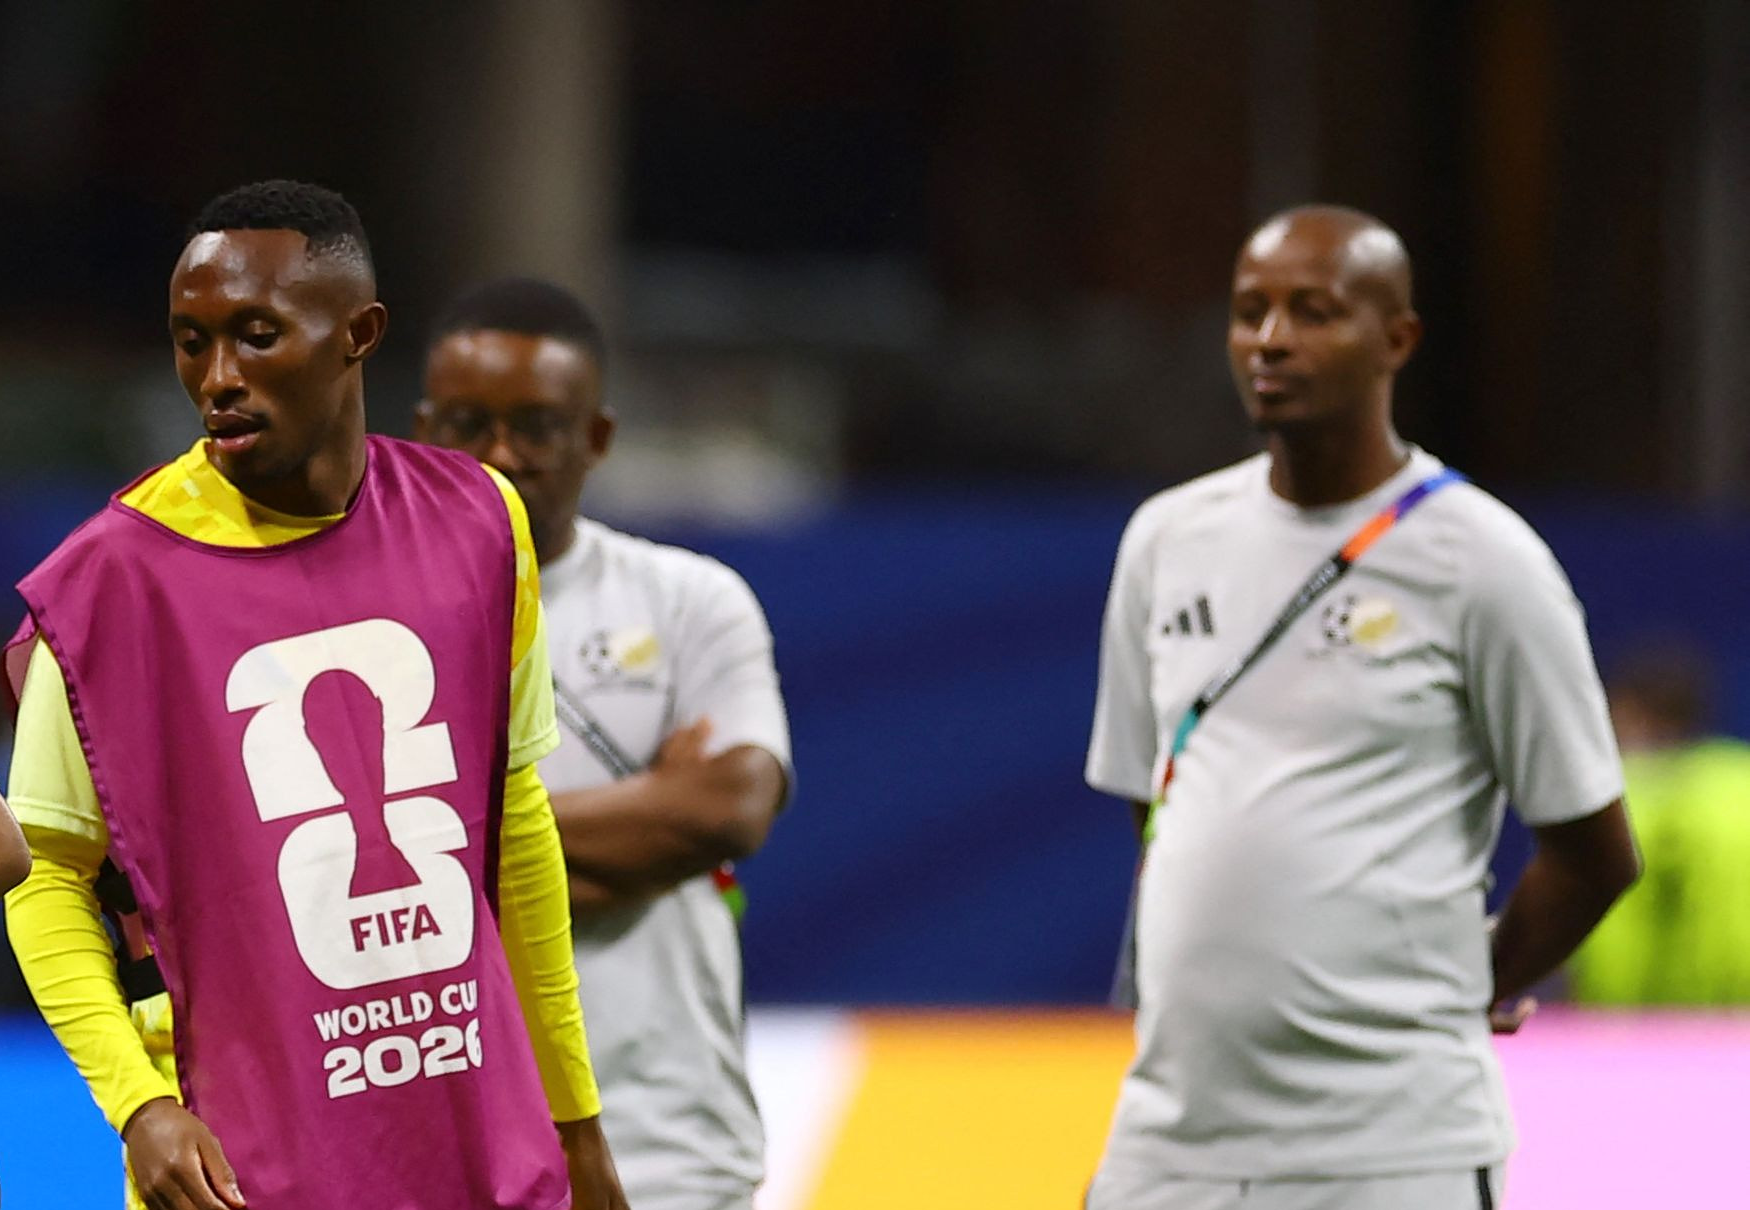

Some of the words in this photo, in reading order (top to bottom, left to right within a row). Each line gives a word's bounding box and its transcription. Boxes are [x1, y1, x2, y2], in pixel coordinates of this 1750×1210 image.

[350, 904, 442, 952] FIFA
[313, 991, 434, 1042] WORLD
[439, 979, 478, 1015] CU
